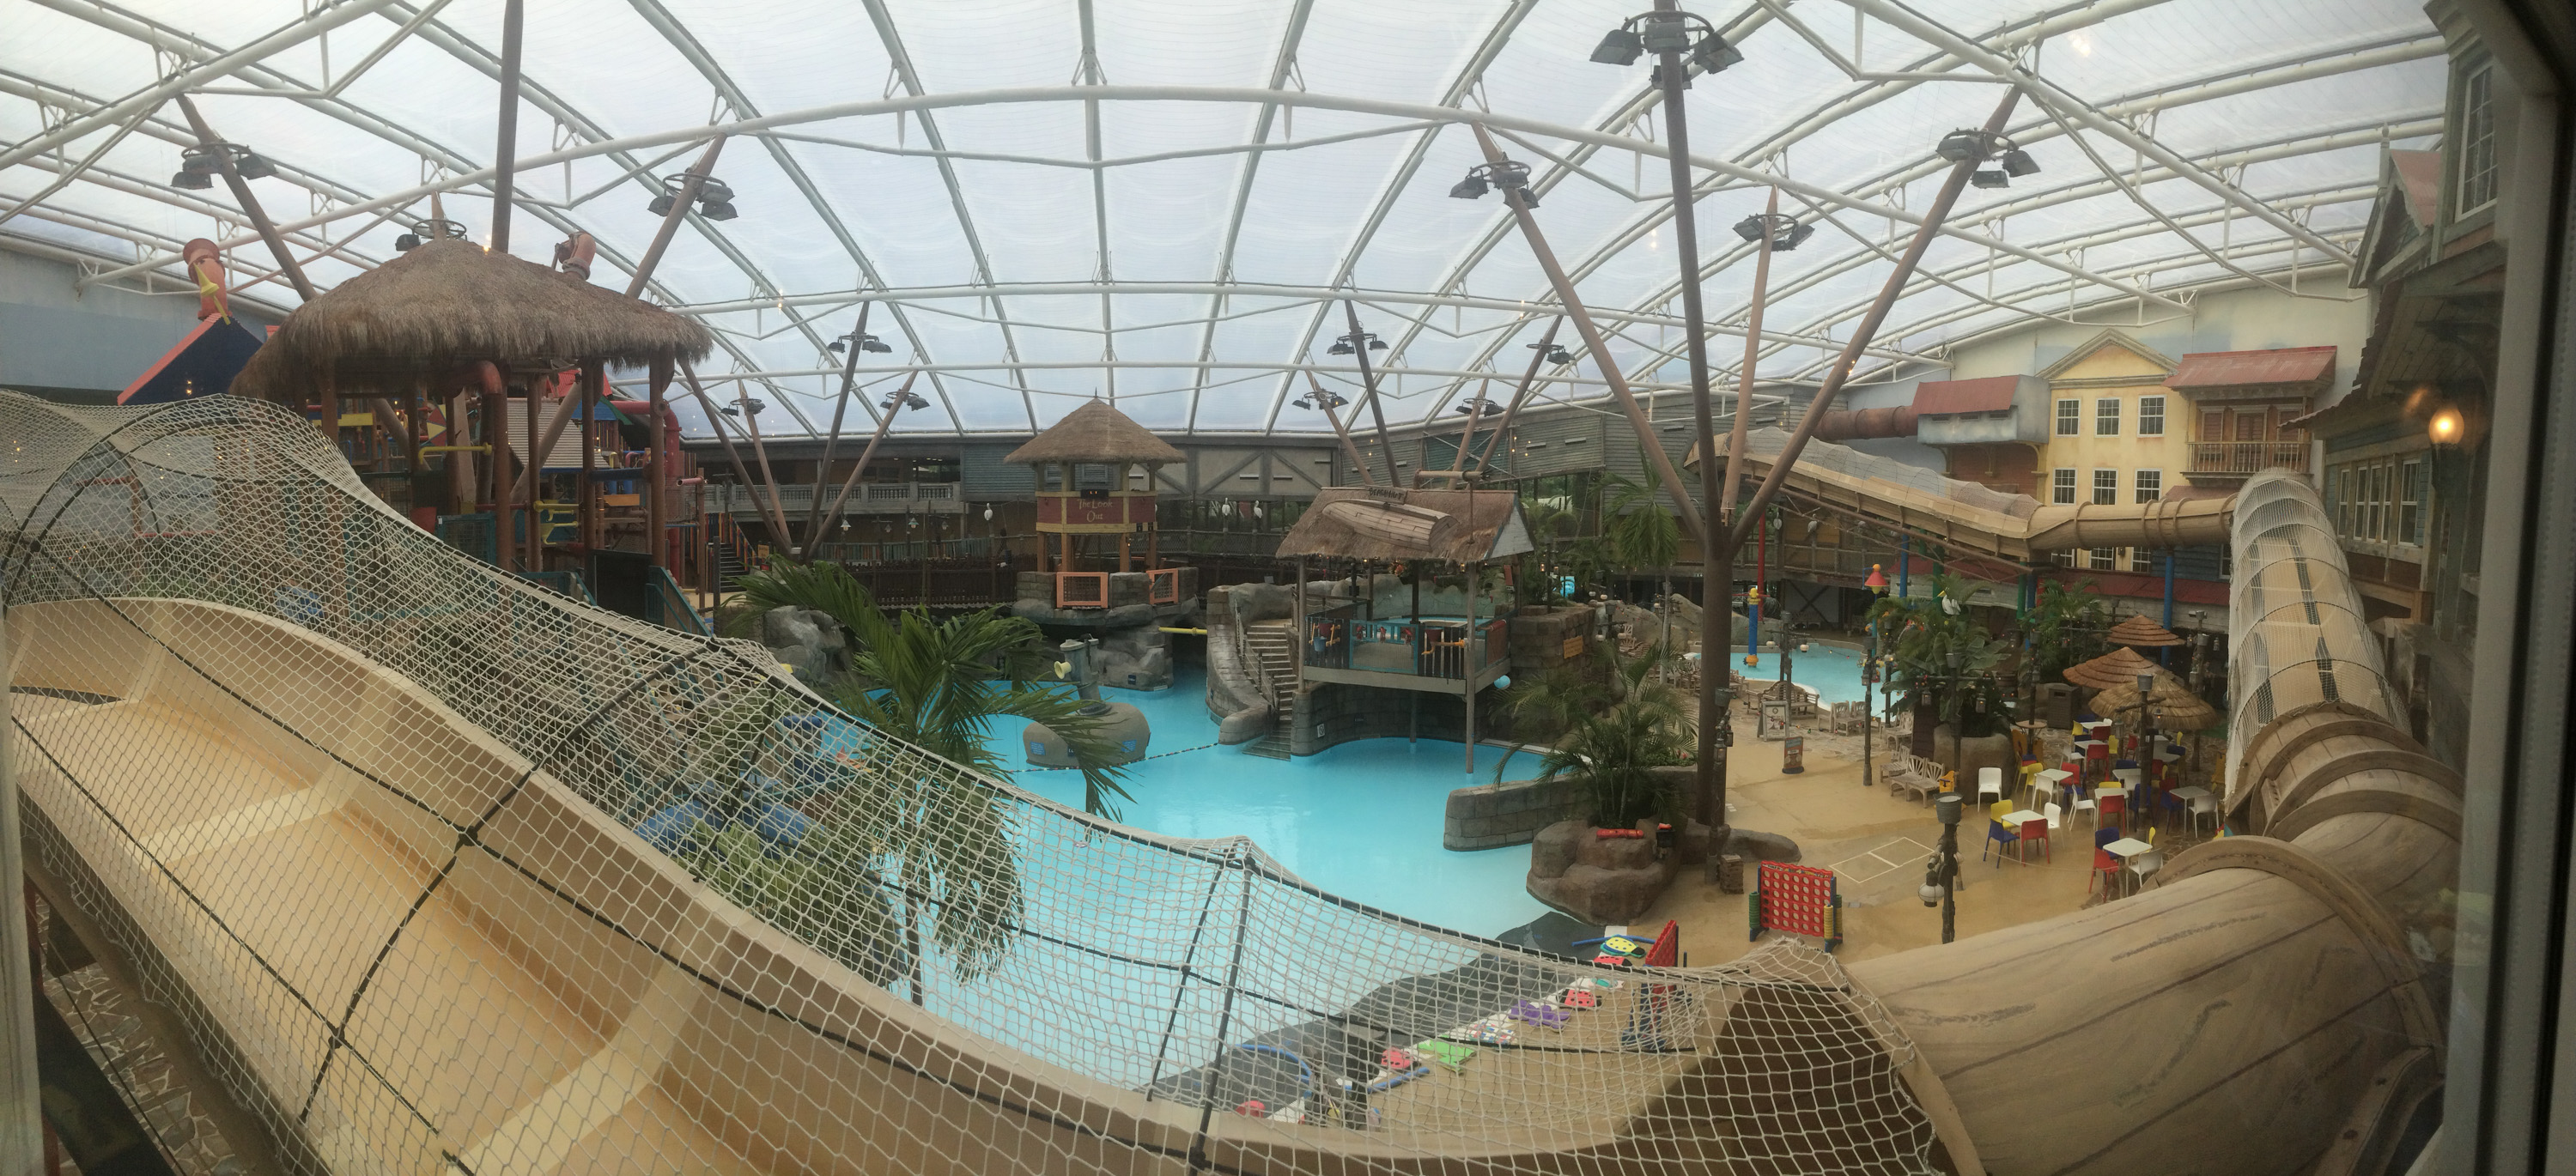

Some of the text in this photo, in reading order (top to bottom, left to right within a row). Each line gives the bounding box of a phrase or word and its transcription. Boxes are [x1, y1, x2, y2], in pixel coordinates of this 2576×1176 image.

[1077, 499, 1113, 510] The Look
[1086, 510, 1103, 523] Out
